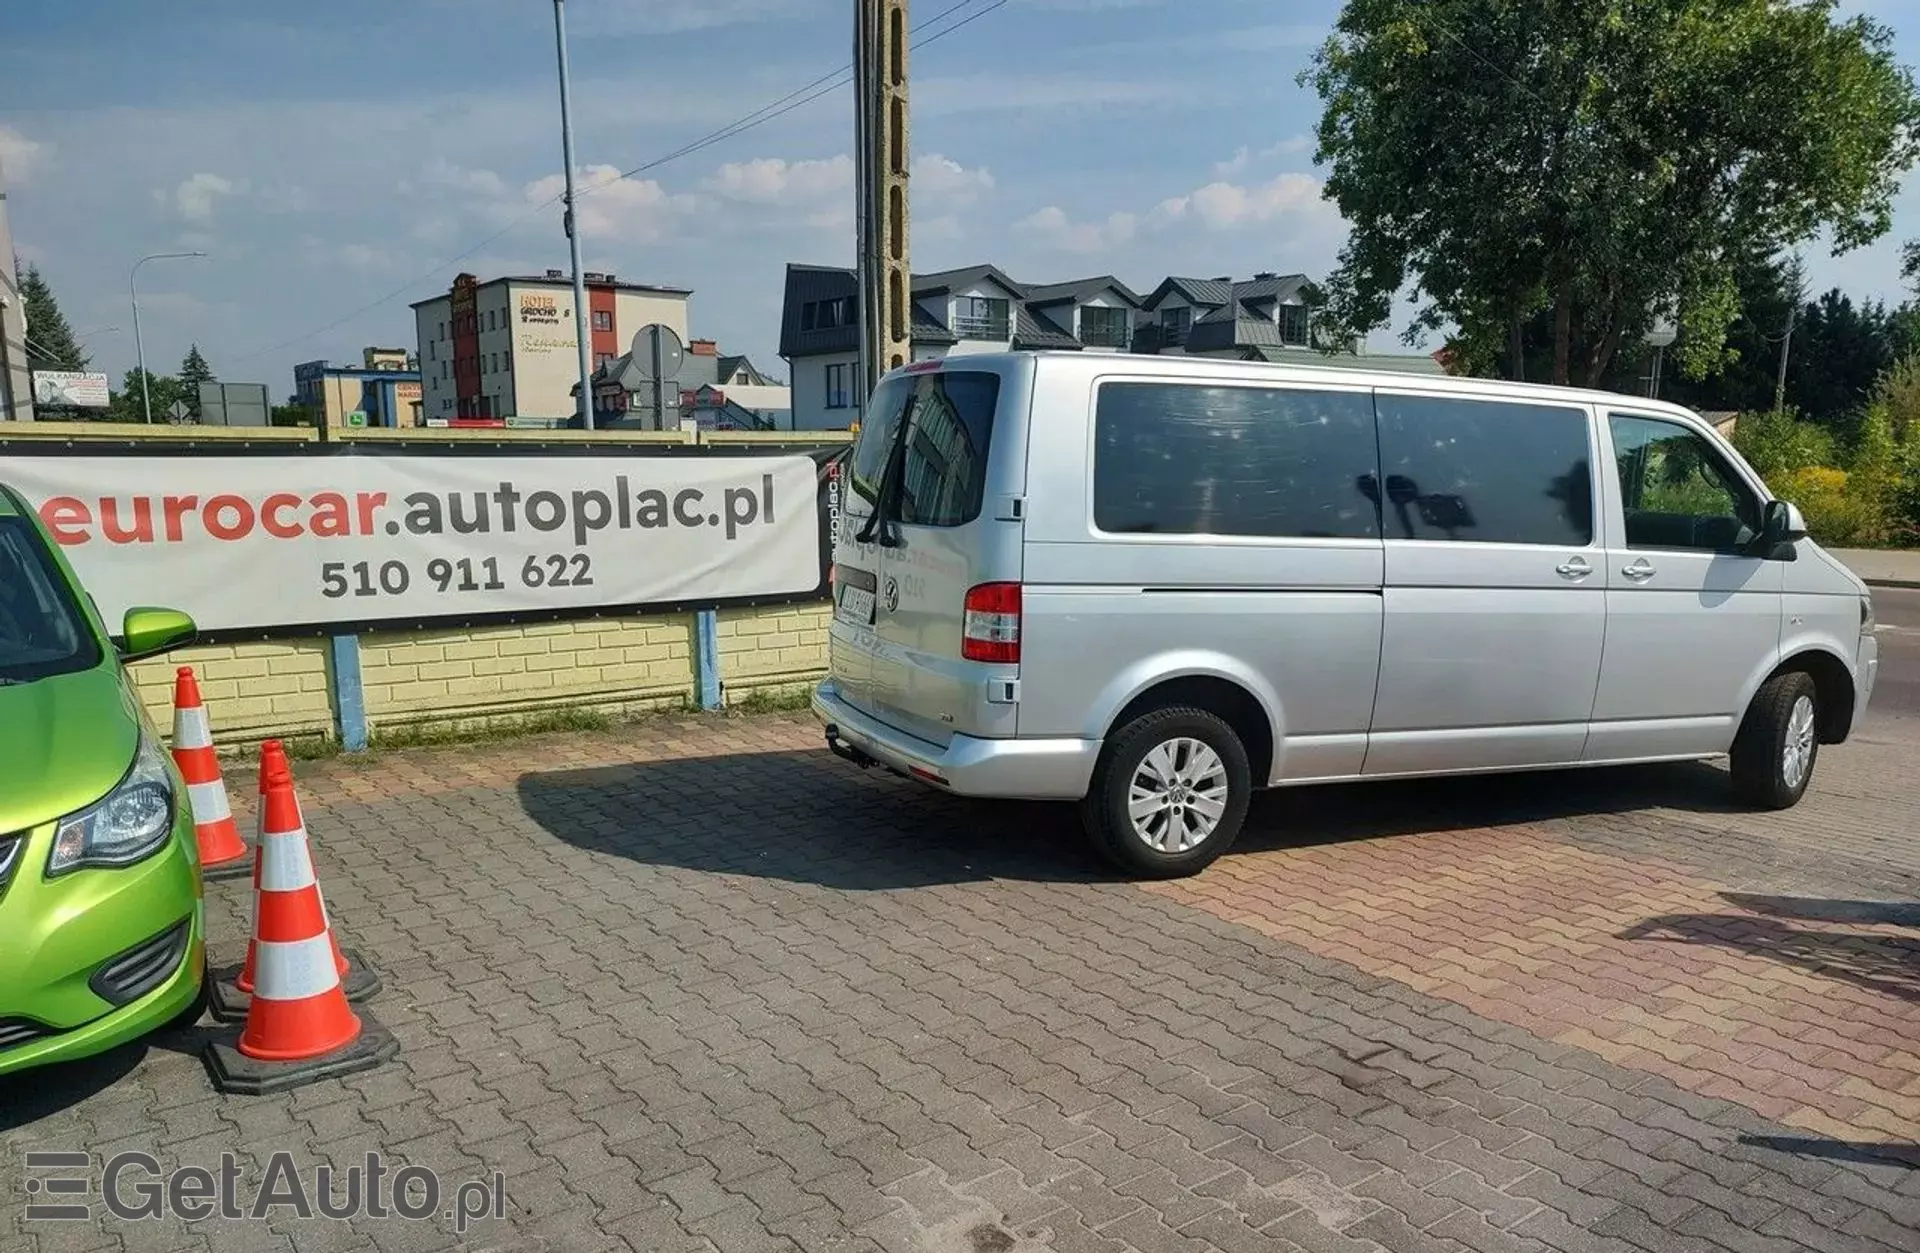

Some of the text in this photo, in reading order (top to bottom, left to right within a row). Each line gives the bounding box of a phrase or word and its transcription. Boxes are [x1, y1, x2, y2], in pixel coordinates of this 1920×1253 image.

[40, 474, 775, 545] eurocar.autoplac.pl
[322, 553, 593, 598] 510 911 622
